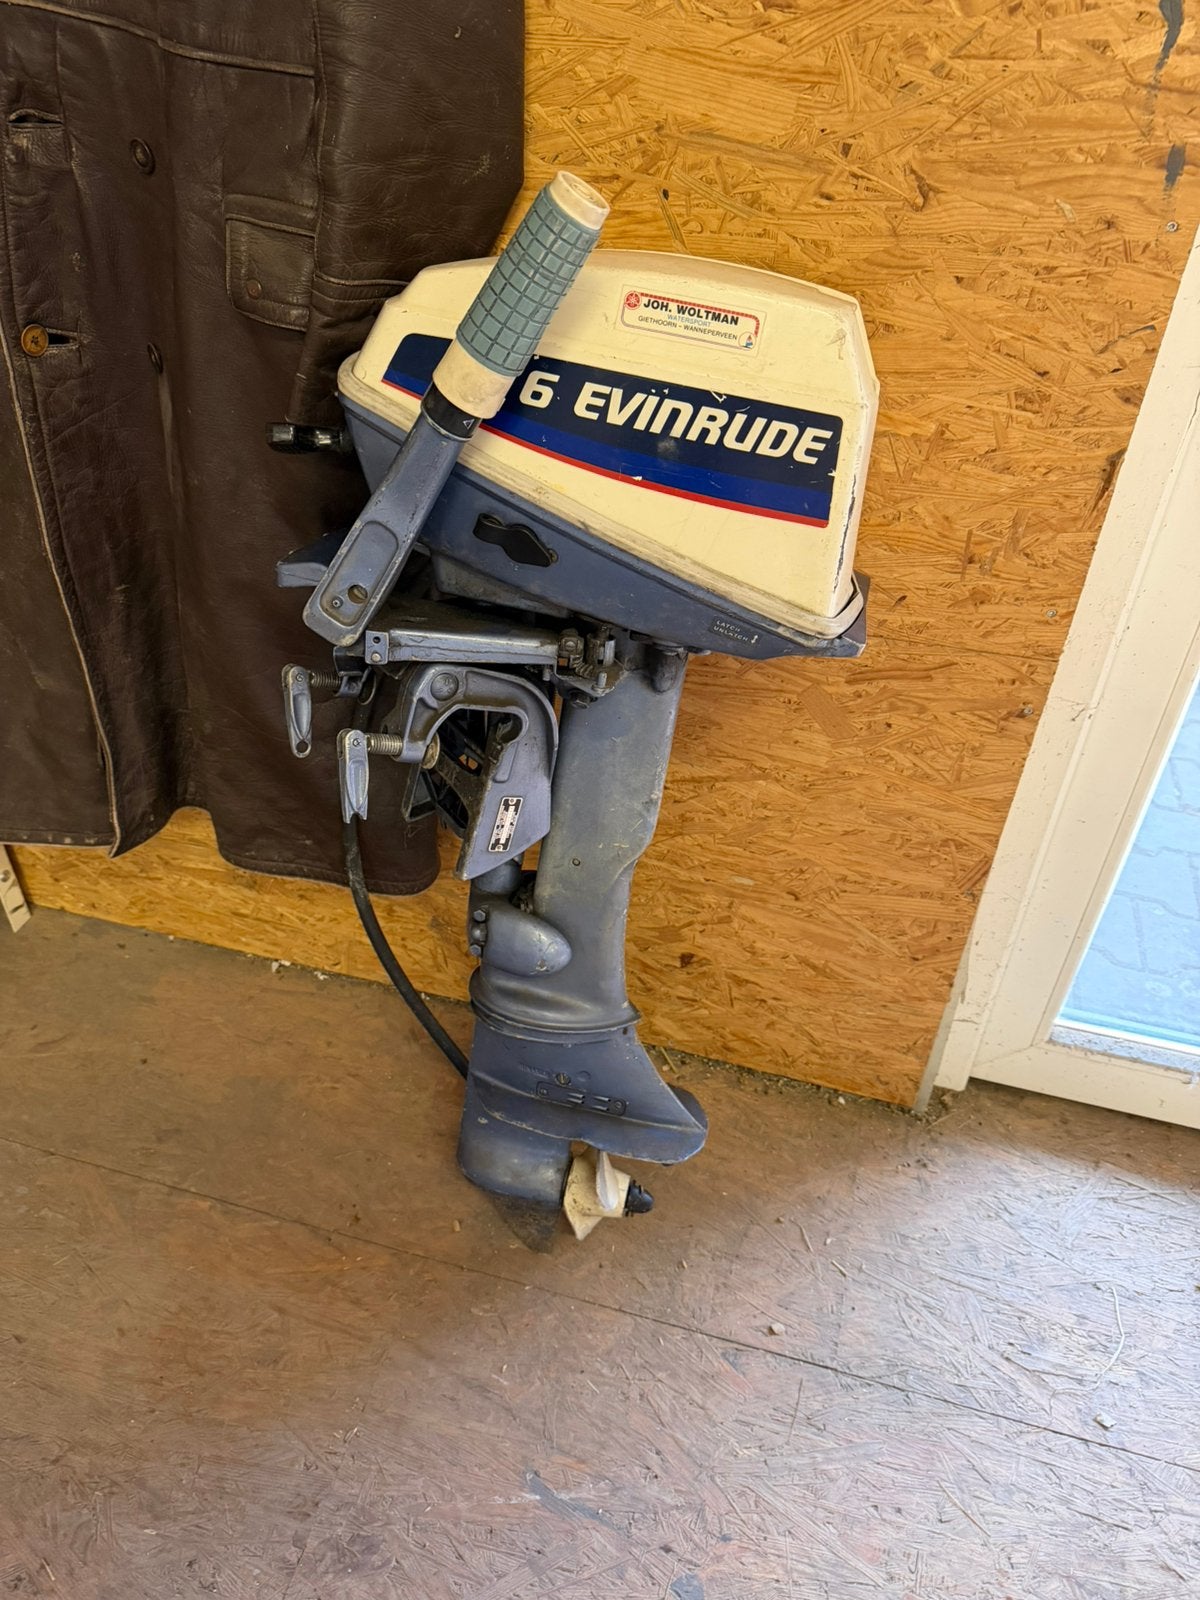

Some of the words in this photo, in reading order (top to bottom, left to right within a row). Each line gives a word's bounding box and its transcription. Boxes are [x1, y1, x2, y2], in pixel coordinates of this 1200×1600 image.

[643, 299, 672, 313] JOH.
[676, 304, 739, 326] WOLTMAN
[667, 314, 711, 327] WATERSPORT
[638, 315, 677, 328] GIETHOORN
[683, 324, 738, 341] WANNEPERVEEN
[519, 370, 560, 409] 6
[573, 381, 833, 465] EVINRUDE
[713, 626, 749, 641] UNLATCH
[716, 620, 741, 632] LATCH
